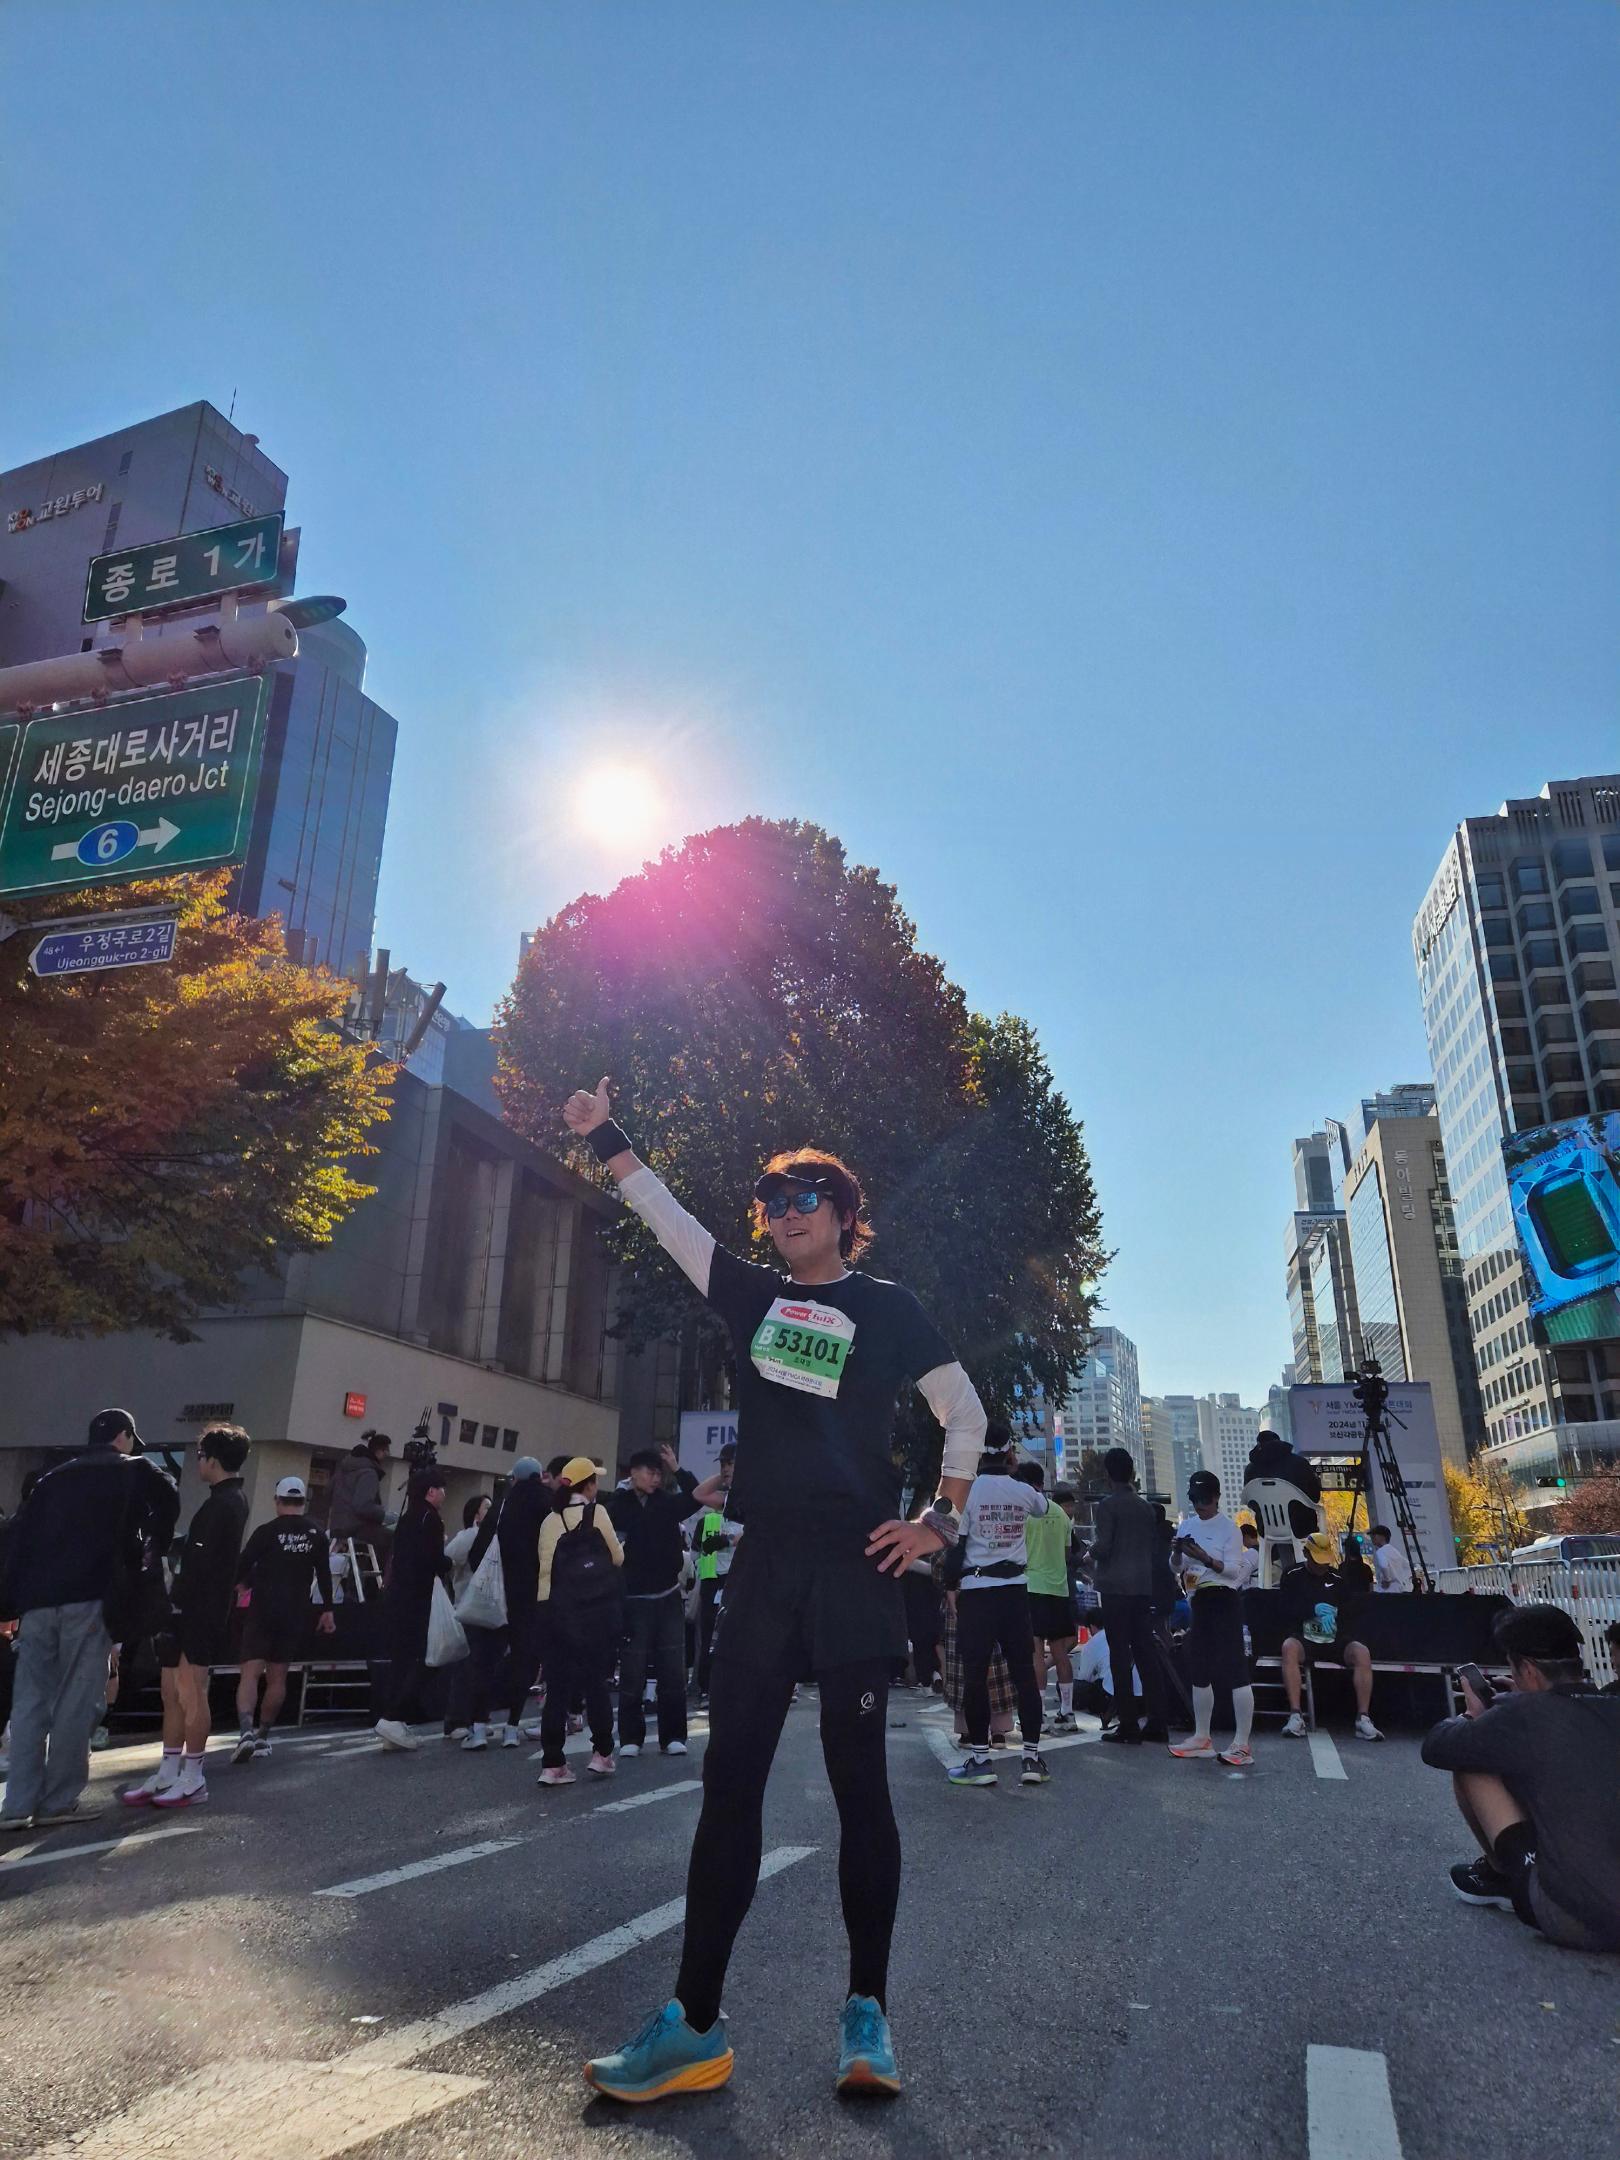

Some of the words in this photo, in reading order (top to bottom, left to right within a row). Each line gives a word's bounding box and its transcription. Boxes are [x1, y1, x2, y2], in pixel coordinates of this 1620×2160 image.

[36, 482, 102, 521] 교원투어
[101, 554, 179, 603] 종로
[203, 532, 266, 577] 1가
[33, 708, 239, 785] 세종대로사거리
[25, 772, 186, 824] Sejong-daero
[189, 760, 230, 793] Jct
[97, 828, 119, 859] 6
[57, 951, 138, 970] Ujeongguk-ro
[140, 945, 168, 959] 2-gil
[79, 924, 172, 953] 우정국로2길
[1394, 1150, 1416, 1220] 동아빌딩
[758, 1325, 776, 1345] B
[774, 1328, 840, 1365] 53101
[1344, 1401, 1364, 1409] YMC
